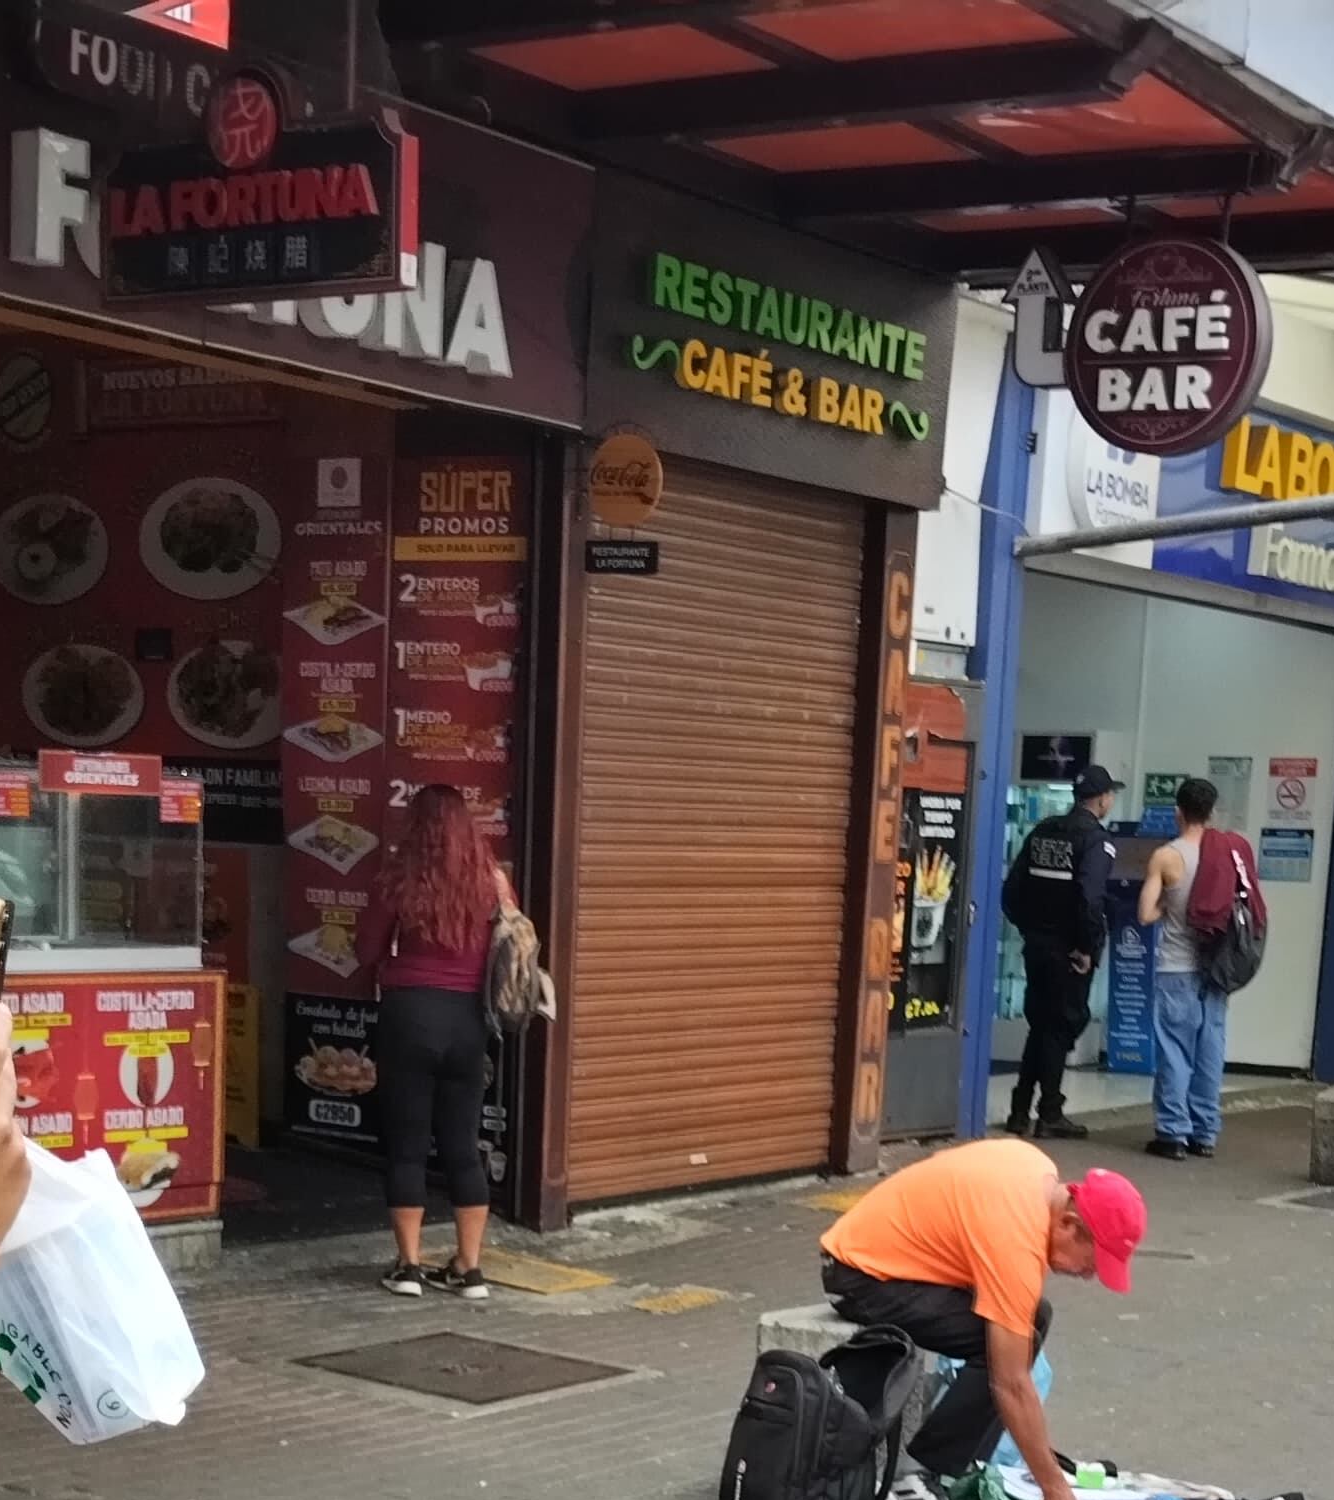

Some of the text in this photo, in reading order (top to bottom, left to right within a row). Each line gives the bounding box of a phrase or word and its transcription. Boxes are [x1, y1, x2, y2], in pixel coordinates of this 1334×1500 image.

[110, 163, 380, 238] LA FORTUNA
[651, 250, 927, 382] RESTAURANTE
[1083, 288, 1234, 354] CAFÉ
[674, 338, 885, 436] CAFÉ & BAR
[1096, 364, 1213, 413] BAR
[1220, 416, 1282, 500] LA
[419, 464, 512, 513] SÚPER
[1085, 467, 1150, 509] LA BOMBA
[419, 517, 510, 535] PROMOS
[446, 543, 475, 553] PARA
[475, 543, 516, 553] LLEVAR
[590, 545, 651, 558] RESTAURANTE
[594, 558, 646, 570] LA FORTUNA
[398, 573, 480, 602] 2 ENTEROS
[394, 640, 461, 670] 1 ENTERO
[394, 708, 452, 737] 1 MEDIO
[388, 779, 408, 808] 2
[1030, 836, 1074, 856] FUERZA
[21, 991, 65, 1014] ASADO
[332, 1023, 367, 1039] helado
[29, 1111, 74, 1135] ASADO
[144, 1106, 185, 1129] ASADO
